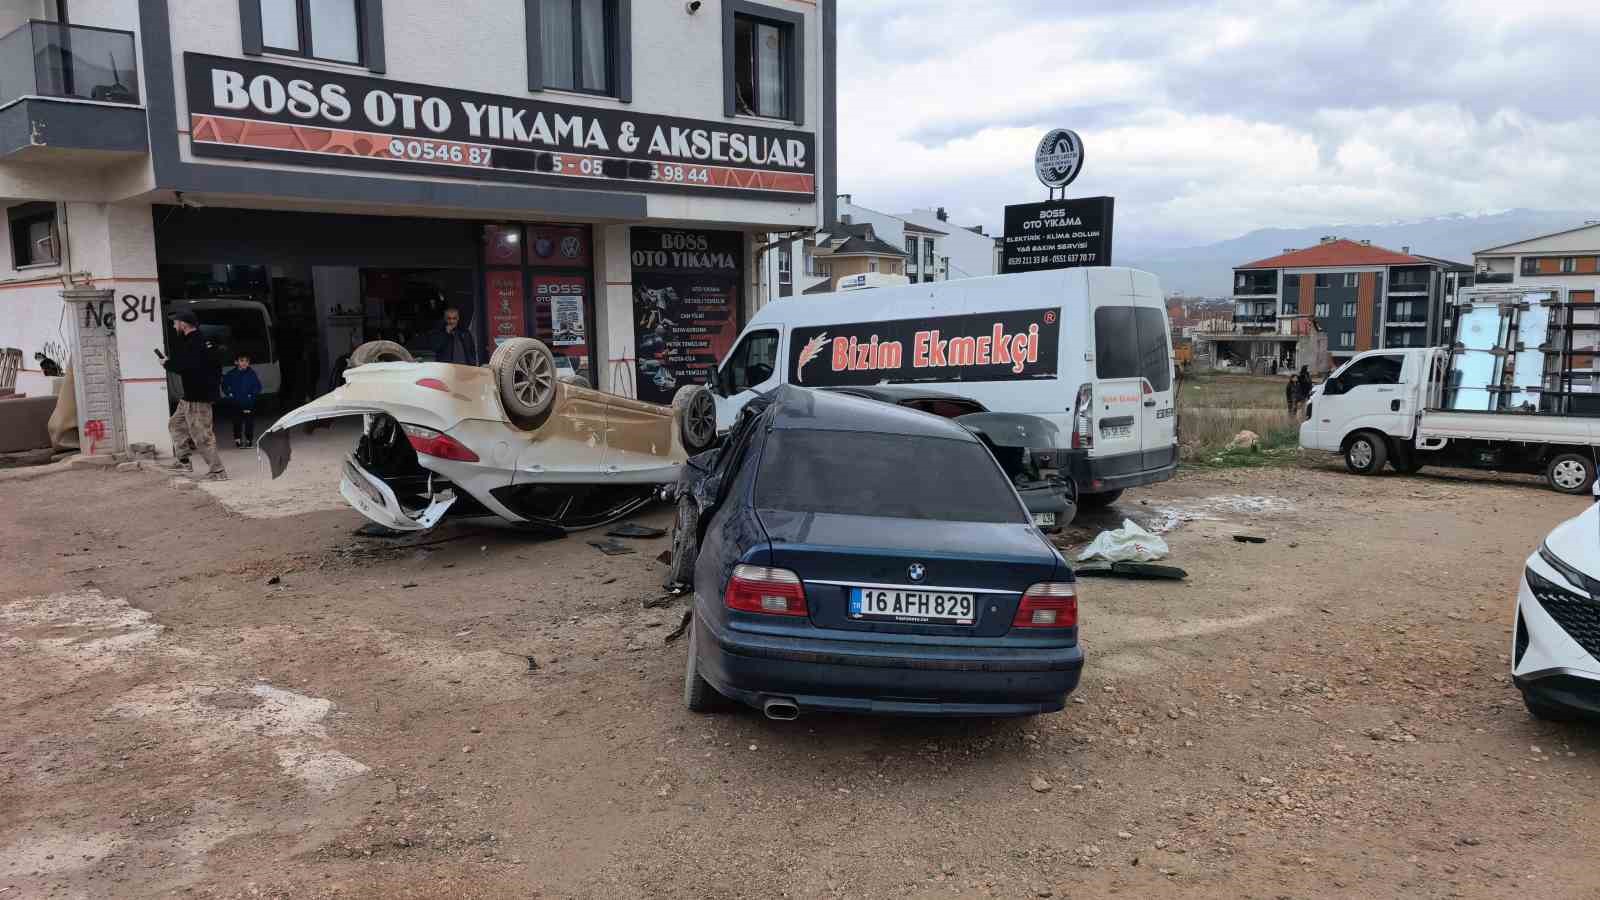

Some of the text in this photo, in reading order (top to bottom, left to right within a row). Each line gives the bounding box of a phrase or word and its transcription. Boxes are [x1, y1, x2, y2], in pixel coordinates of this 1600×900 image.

[211, 68, 806, 168] BOSS OTO YIKAMA & AKSESUAR
[407, 141, 463, 161] 0546
[664, 166, 684, 183] 98
[688, 168, 708, 184] 44
[1023, 217, 1082, 230] OTO YIKAMA
[1040, 209, 1066, 219] BOSS
[661, 233, 708, 250] BOSS
[632, 250, 736, 269] OTO YIKAMA
[537, 284, 584, 294] BOSS
[121, 295, 156, 322] 84
[831, 334, 903, 371] Bizim
[914, 322, 1039, 374] Ekmekçi
[865, 590, 971, 616] 16 AFH 829
